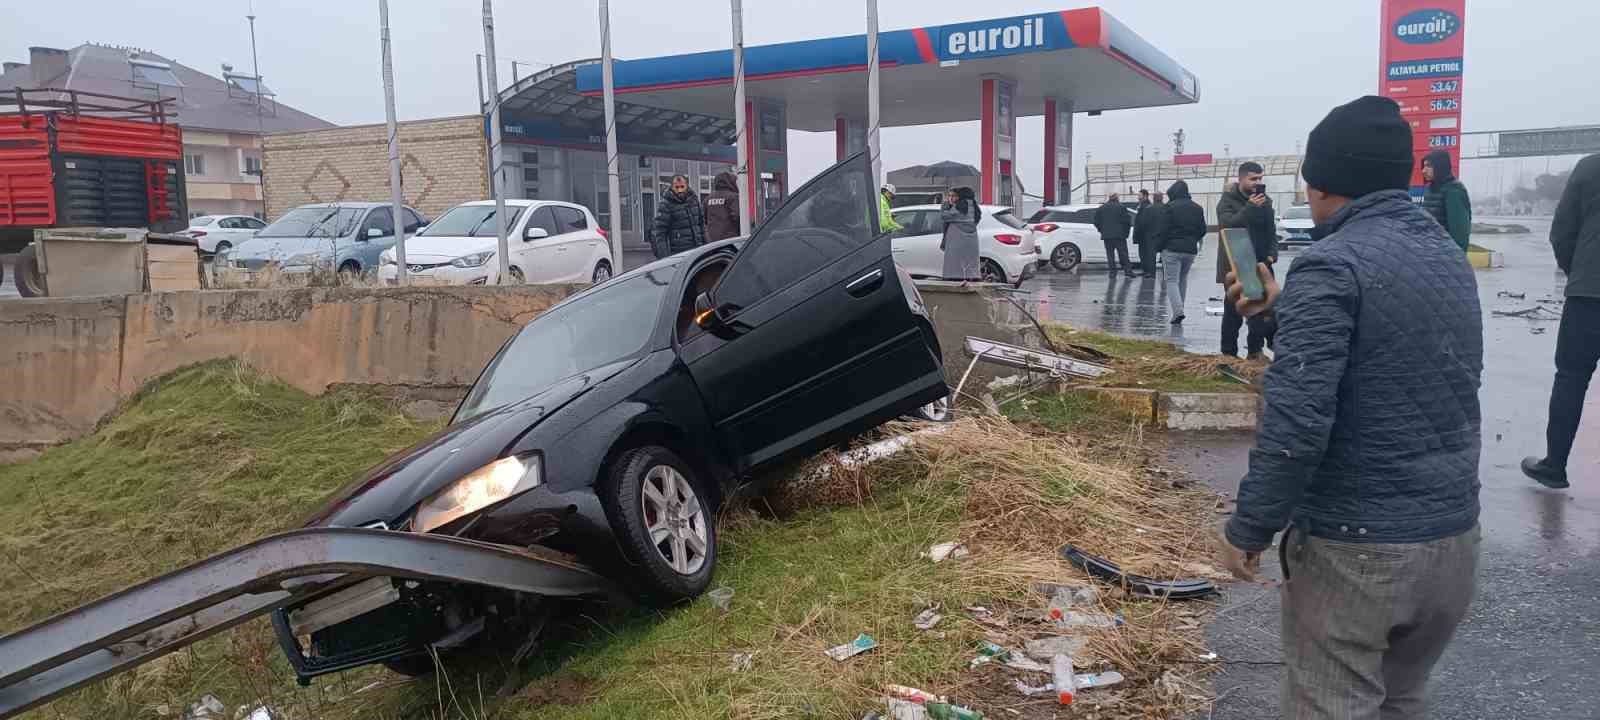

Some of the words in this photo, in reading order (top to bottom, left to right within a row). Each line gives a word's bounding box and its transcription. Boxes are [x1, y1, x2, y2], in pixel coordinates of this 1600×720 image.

[1397, 18, 1447, 36] euroil
[948, 17, 1044, 55] euroil
[1390, 64, 1429, 76] ALTAYLAR
[1430, 62, 1460, 73] PETROL
[1430, 80, 1458, 93] 53.47
